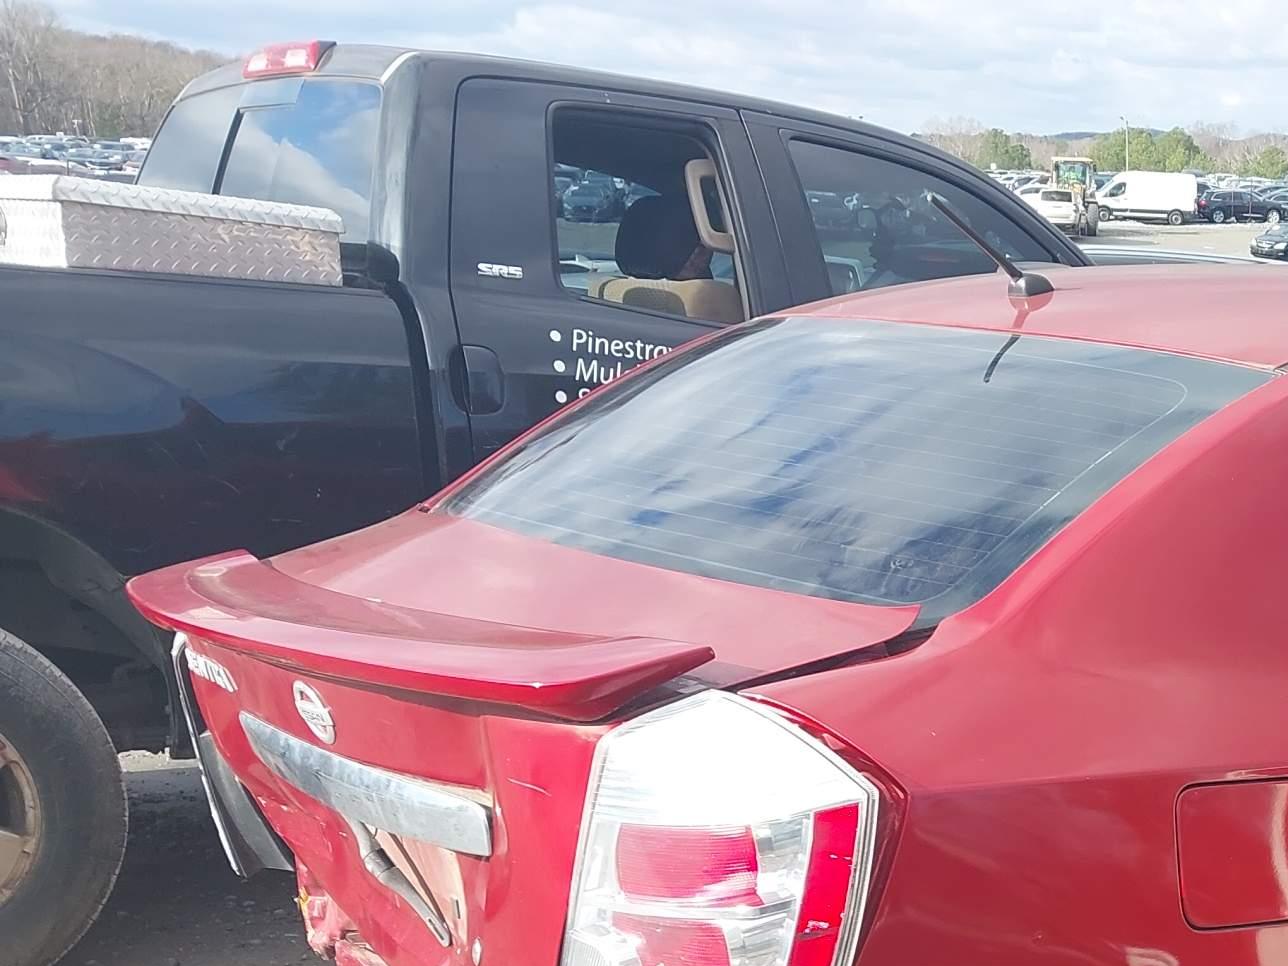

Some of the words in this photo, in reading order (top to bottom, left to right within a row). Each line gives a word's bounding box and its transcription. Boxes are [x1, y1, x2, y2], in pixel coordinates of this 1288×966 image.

[477, 263, 523, 279] SR5
[571, 328, 673, 361] Pinestra
[575, 358, 642, 385] Mul
